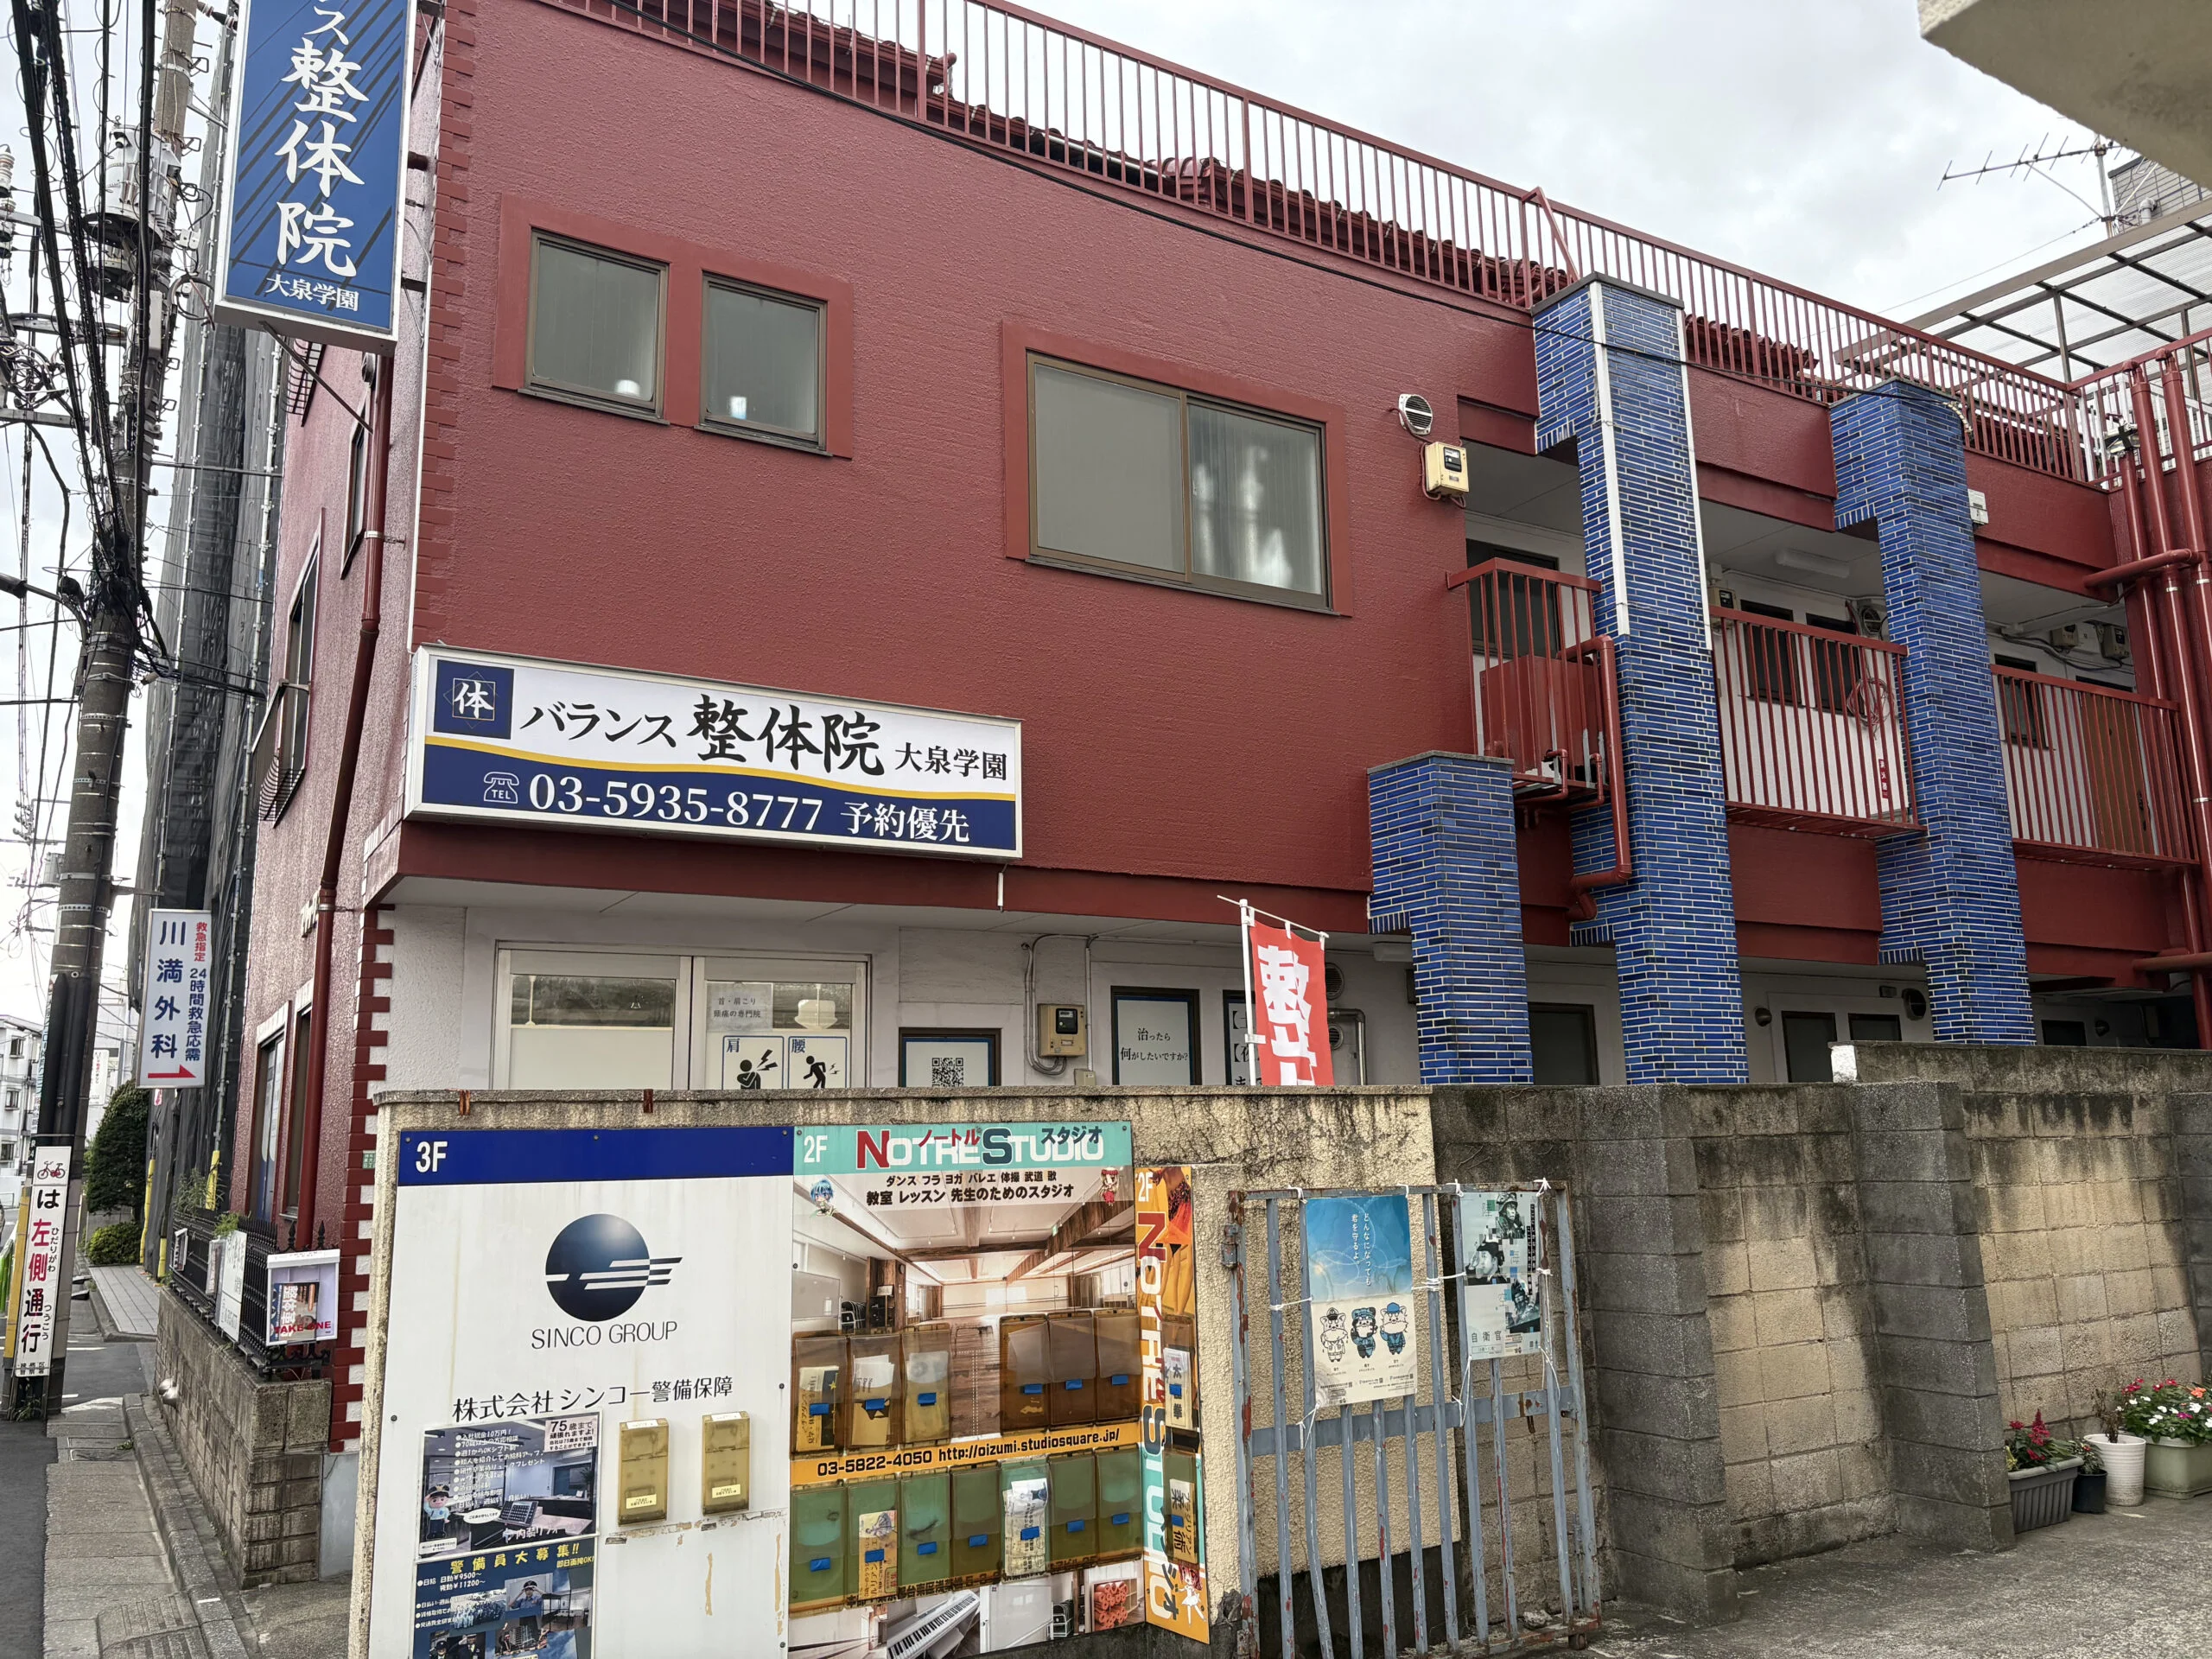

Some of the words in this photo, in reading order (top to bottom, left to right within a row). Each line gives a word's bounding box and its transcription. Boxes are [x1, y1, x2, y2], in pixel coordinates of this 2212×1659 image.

[275, 0, 369, 276] ス整体院
[266, 273, 359, 311] 大泉学園
[454, 680, 495, 719] 体
[520, 701, 677, 748] バランス
[687, 694, 885, 776] 整体院
[894, 741, 1007, 781] 大泉学園
[491, 789, 512, 800] TEL
[529, 773, 823, 831] 03-5935-8777
[840, 801, 970, 842] 予約優先
[194, 921, 207, 962] 救急指定
[150, 920, 187, 1059] 川満外科
[185, 968, 207, 1061] 24時間救急応需
[726, 1038, 741, 1053] 肩
[791, 1039, 806, 1054] 腰
[1137, 1027, 1171, 1041] 治ったら
[804, 1134, 828, 1164] 2F
[918, 1127, 981, 1147] ノートル
[1040, 1126, 1103, 1146] スタジオ
[415, 1141, 448, 1173] 3F
[867, 1190, 893, 1206] 教室
[899, 1190, 946, 1203] レッスン
[951, 1183, 1075, 1203] 先生のためのスタジオ
[886, 1175, 918, 1187] ダンス
[922, 1175, 941, 1186] フラ
[946, 1173, 963, 1185] ヨガ
[969, 1173, 996, 1184] バレエ
[1001, 1171, 1020, 1183] 体操
[1024, 1171, 1044, 1182] 武道
[1047, 1170, 1057, 1181] 歌
[1137, 1171, 1154, 1202] 2F
[47, 1227, 59, 1273] ひだりがわ
[1351, 1213, 1360, 1265] 君を守るよ。
[1363, 1212, 1372, 1287] どんなになっても
[275, 1324, 304, 1335] TAKE
[307, 1320, 332, 1331] ONE
[531, 1325, 601, 1351] SINCO
[608, 1321, 678, 1344] GROUP
[1471, 1330, 1502, 1343] 自衛官
[817, 1449, 932, 1477] 03-5822-4050
[938, 1427, 1121, 1463] http://oizumi.studiosquare.jp/
